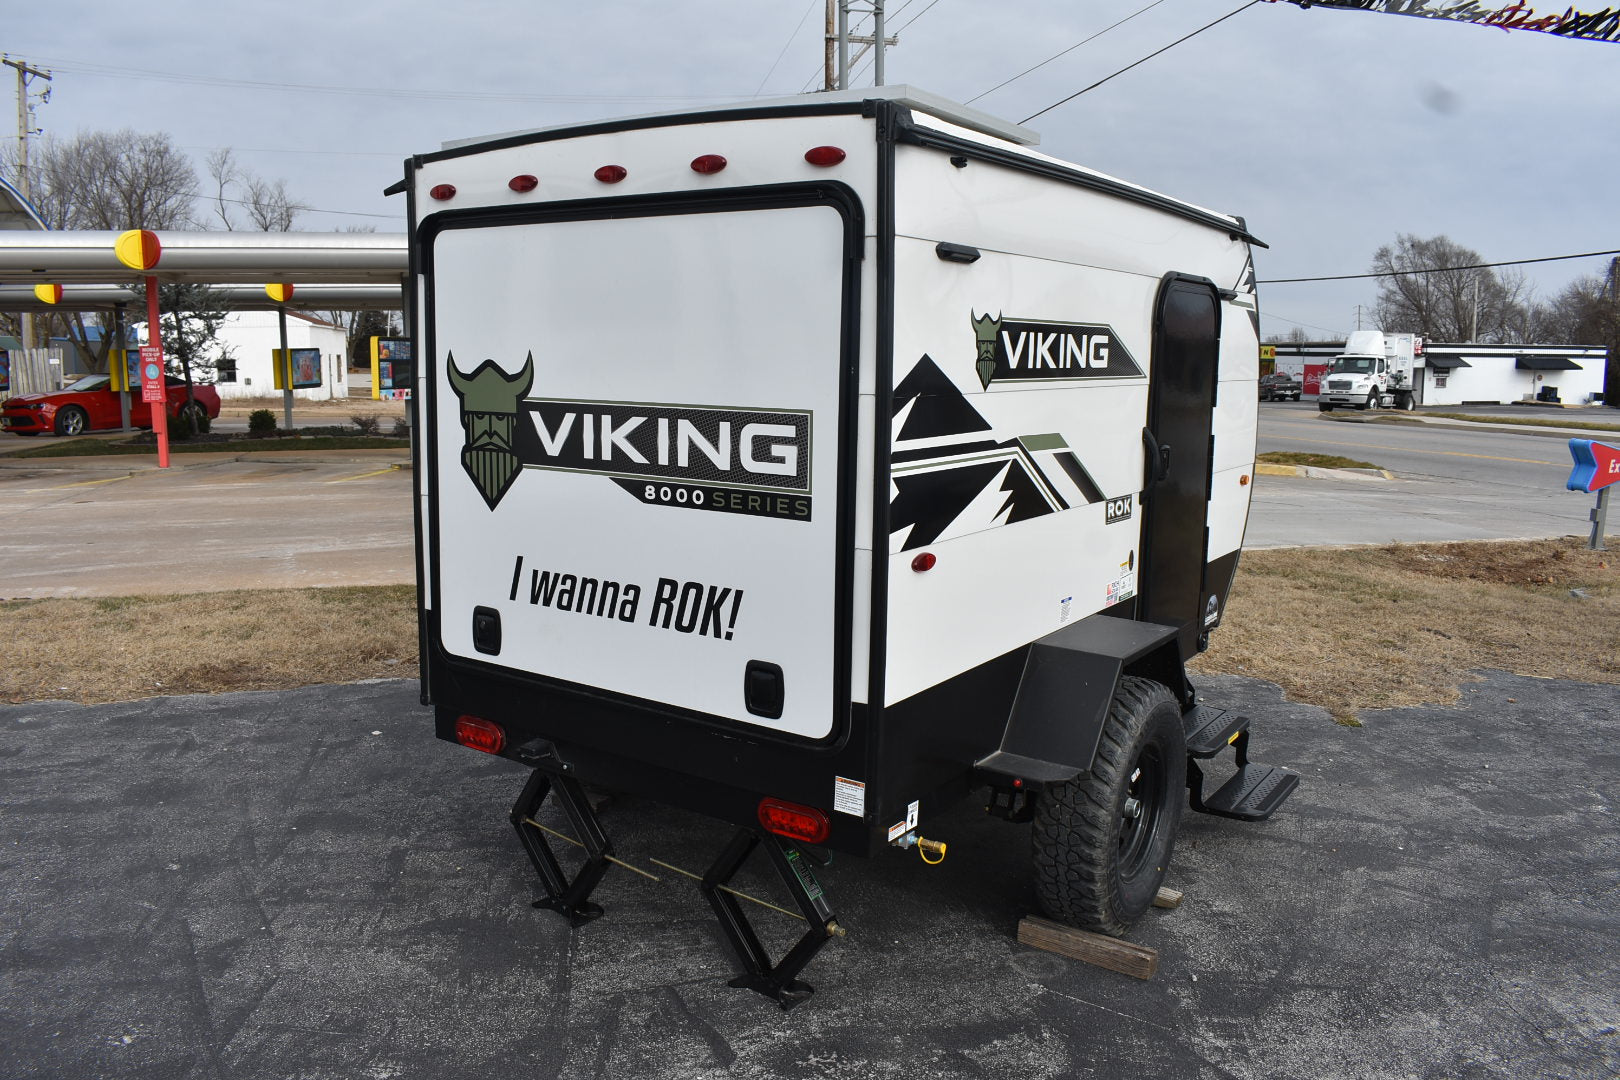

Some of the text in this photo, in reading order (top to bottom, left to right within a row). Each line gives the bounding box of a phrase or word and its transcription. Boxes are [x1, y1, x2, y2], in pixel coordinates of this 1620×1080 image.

[1001, 330, 1109, 369] VIKING
[529, 410, 798, 477] VIKING
[644, 485, 809, 516] 8000 SERIES
[1107, 497, 1131, 518] ROK
[509, 555, 744, 642] I wanna ROK!
